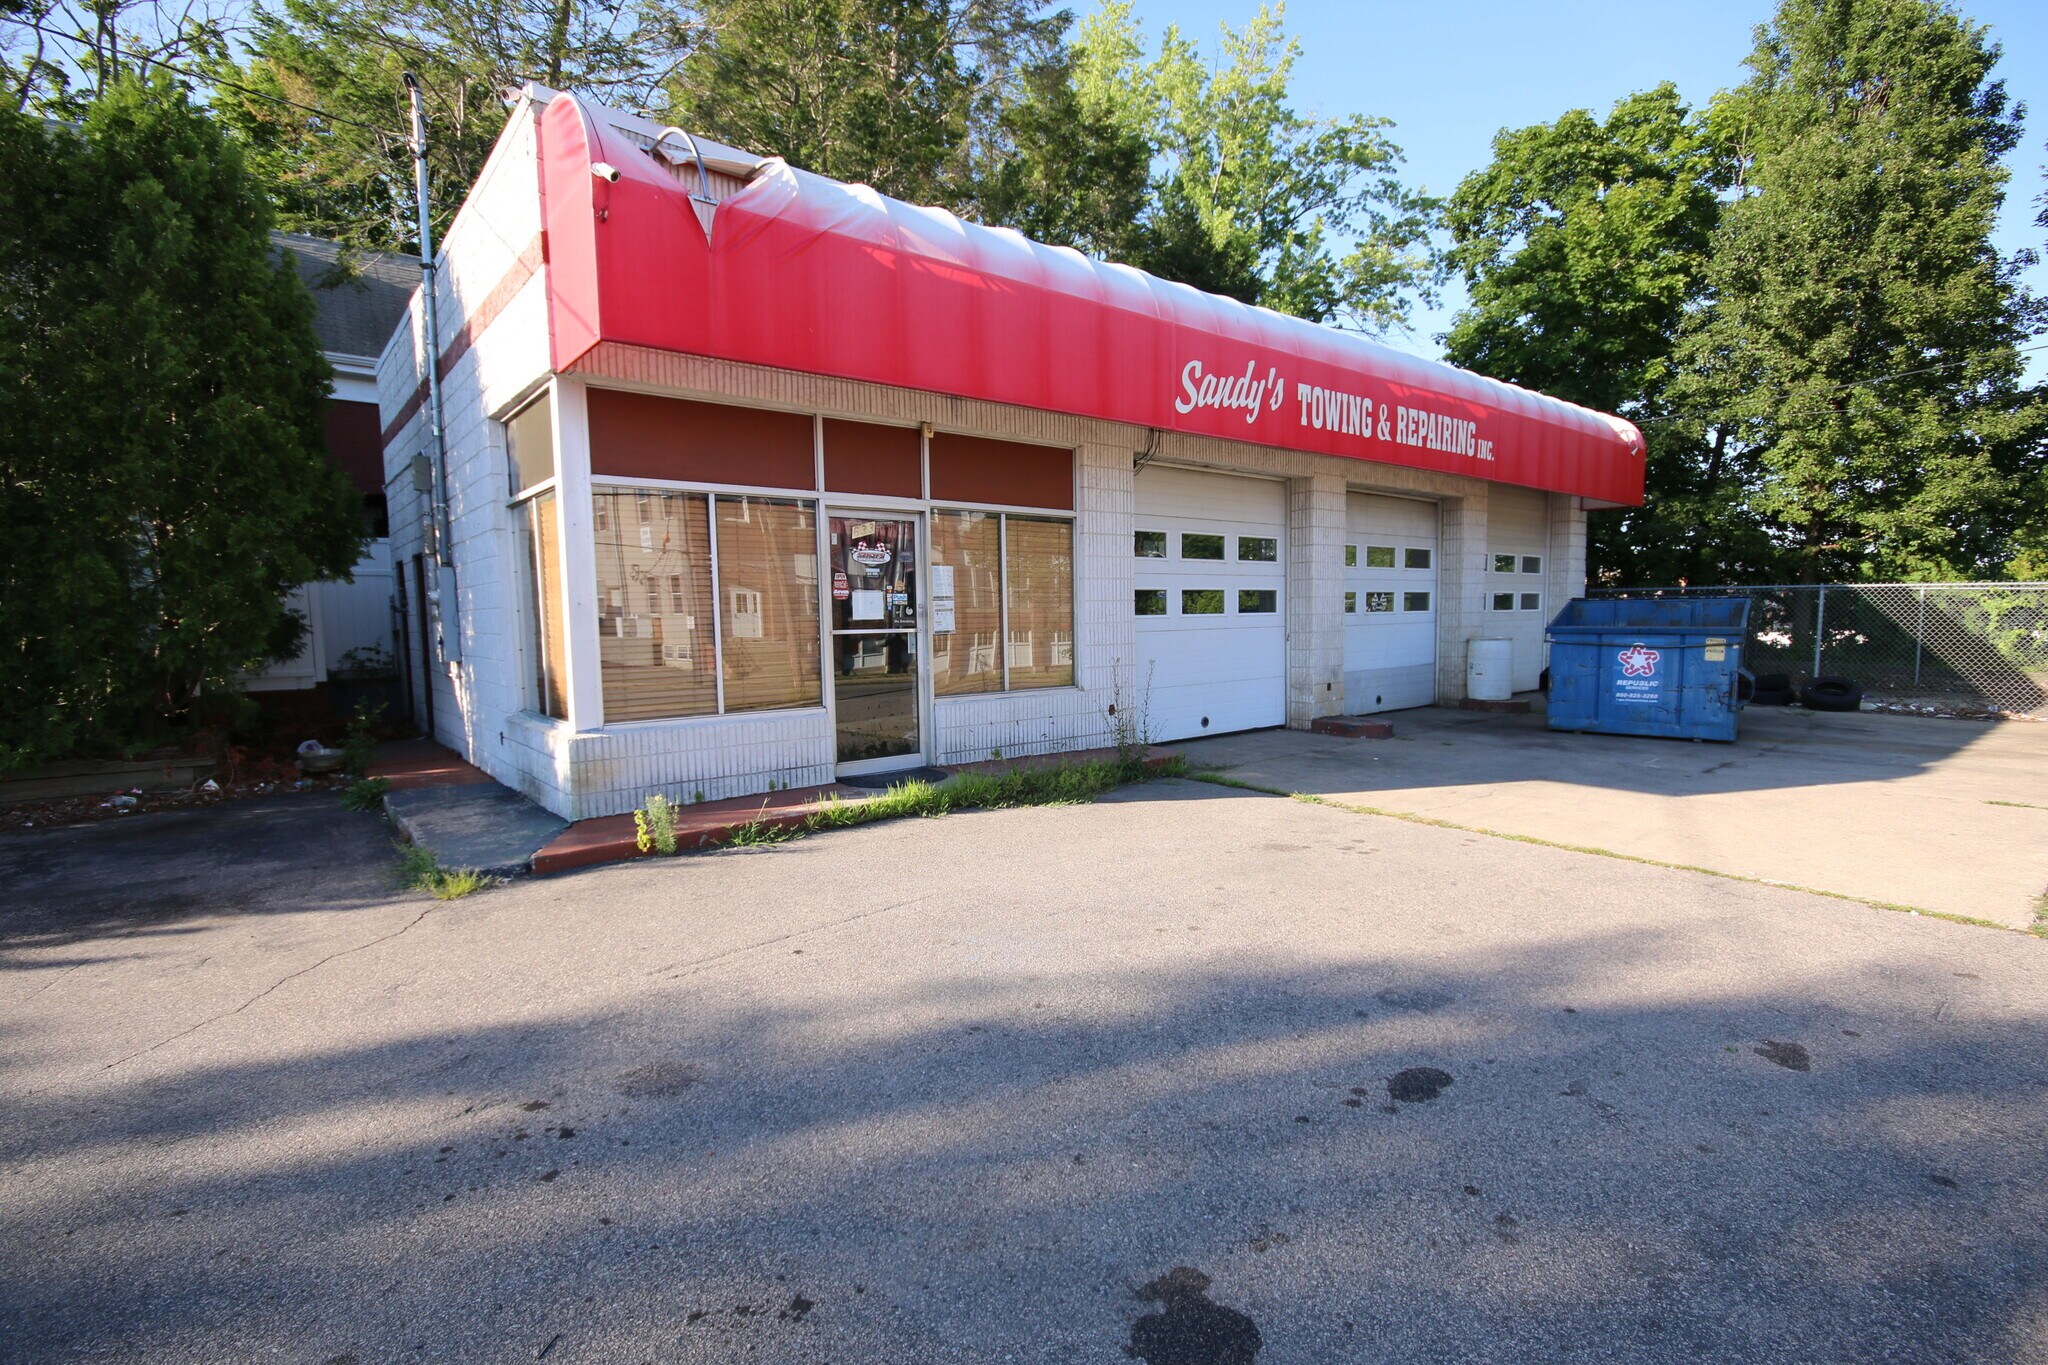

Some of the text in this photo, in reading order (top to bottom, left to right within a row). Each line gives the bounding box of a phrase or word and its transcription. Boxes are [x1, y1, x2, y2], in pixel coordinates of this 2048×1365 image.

[1175, 360, 1495, 461] Sandy's TOWING & REPAIRING INC.
